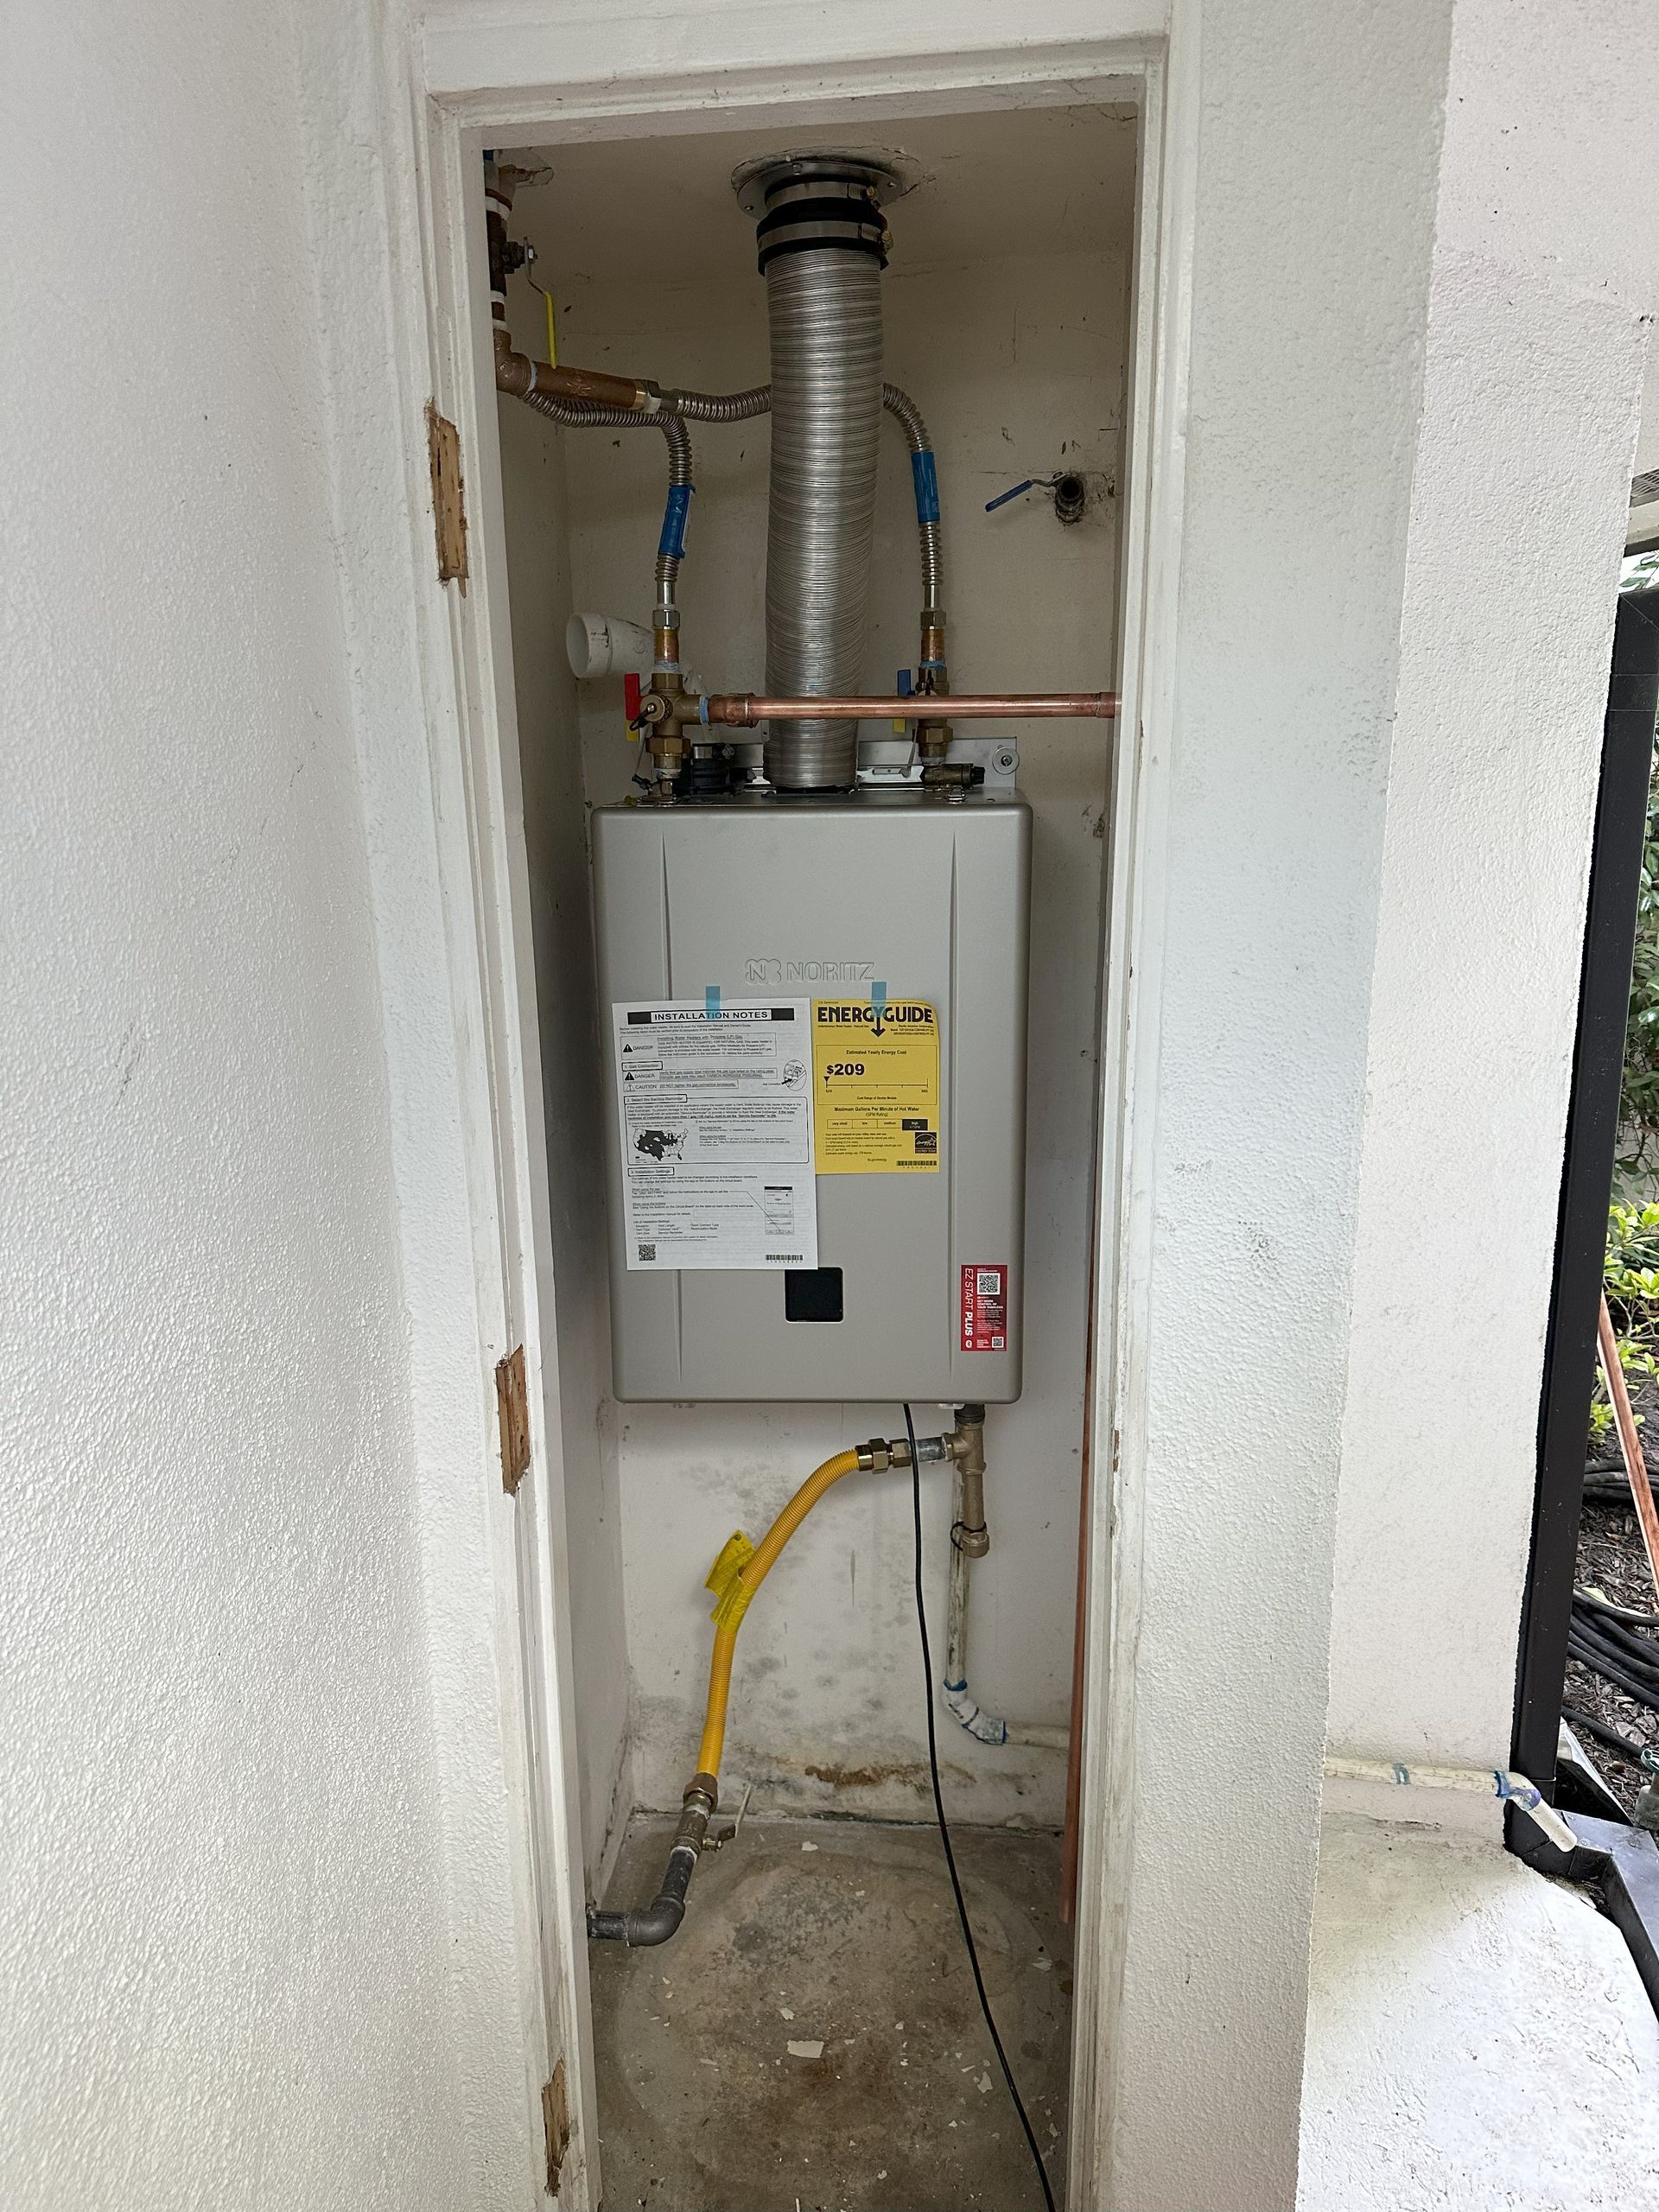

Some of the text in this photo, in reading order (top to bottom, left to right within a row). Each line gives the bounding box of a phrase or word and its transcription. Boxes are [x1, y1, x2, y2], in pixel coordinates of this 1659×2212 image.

[787, 962, 874, 982] NORITZ
[654, 1012, 729, 1020] INSTALLATION
[826, 1064, 865, 1076] $209
[965, 1268, 974, 1337] EZ START PLUS
